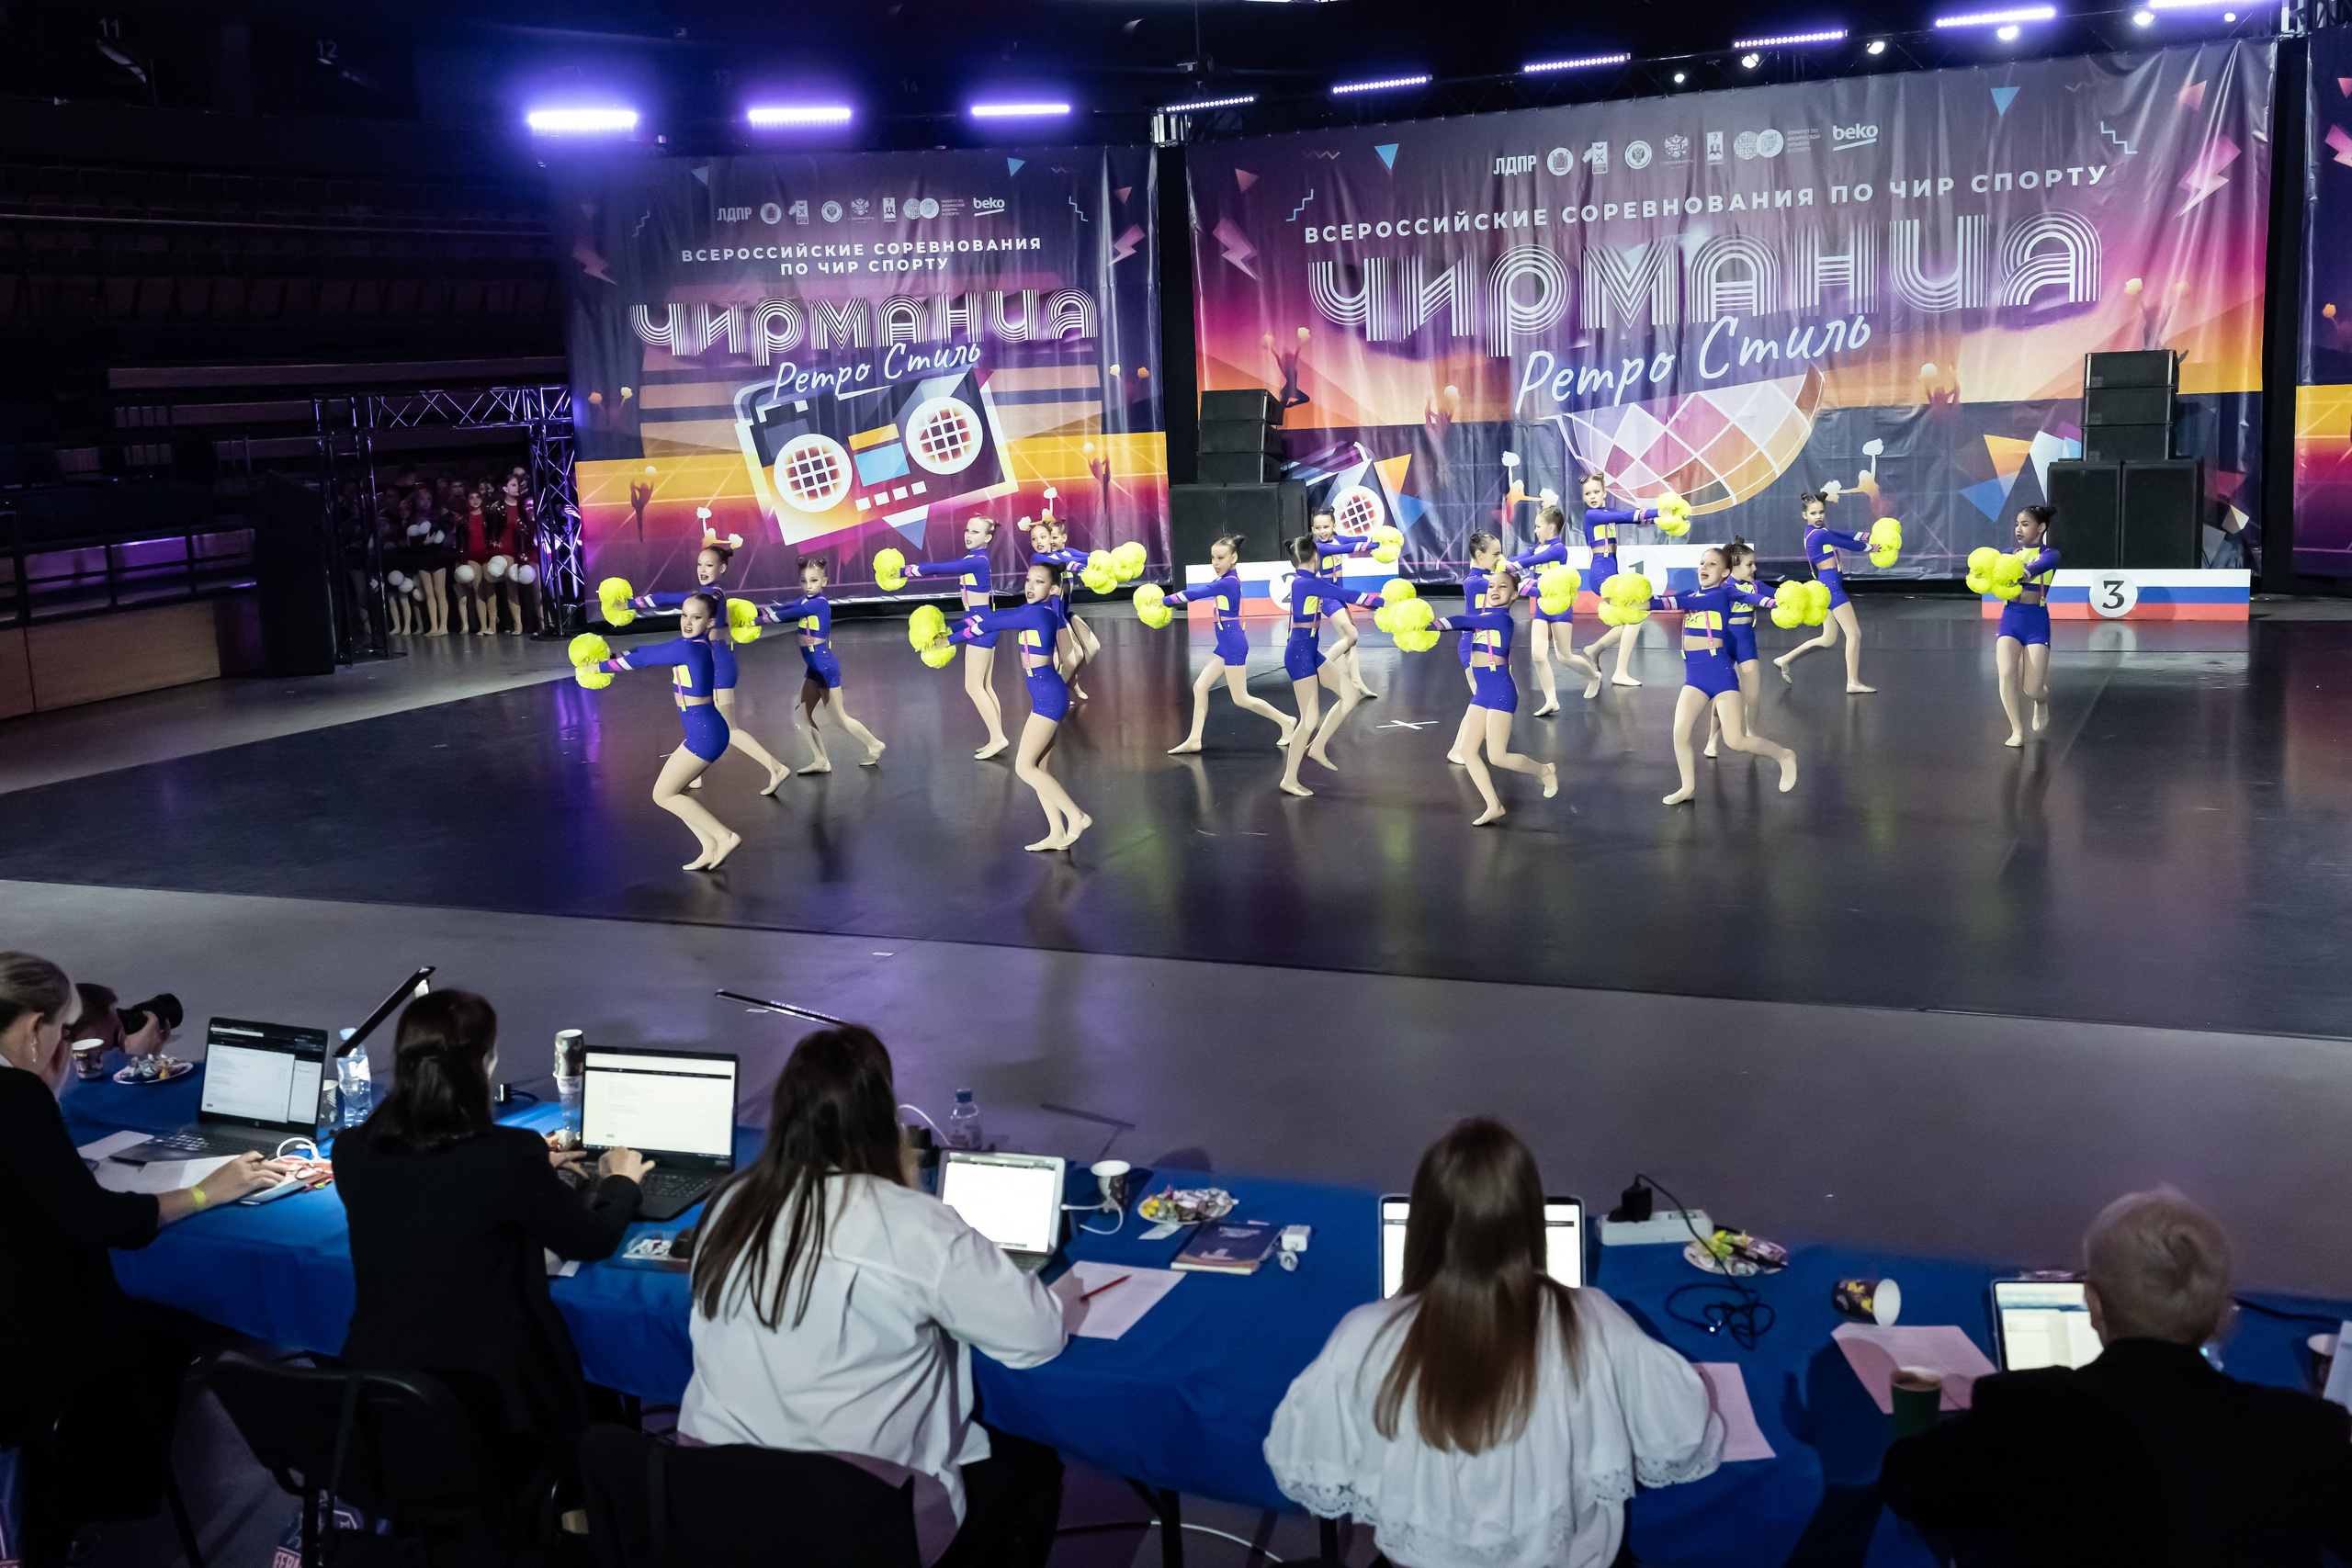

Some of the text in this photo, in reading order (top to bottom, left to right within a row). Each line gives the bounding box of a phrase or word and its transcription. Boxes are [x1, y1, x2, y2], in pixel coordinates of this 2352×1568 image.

[97, 17, 120, 39] 11
[315, 39, 339, 59] 12
[1832, 123, 1878, 141] beko
[1493, 154, 1537, 176] ЛДПР
[973, 197, 1005, 209] beko
[1305, 164, 2108, 243] ВСЕРОССИЙСКИЕ СОРЕВНОВАНИЯ ПО ЧИР СПОРТУ
[717, 207, 752, 223] ЛДПР
[682, 237, 1042, 263] ВСЕРОССИЙСКИЕ СОРЕВНОВАНИЯ
[780, 257, 949, 276] ПО ЧИР СПОРТУ
[773, 342, 982, 400] Ретро Стиль
[1514, 315, 1871, 414] Ретро Стиль
[2101, 580, 2125, 609] 3
